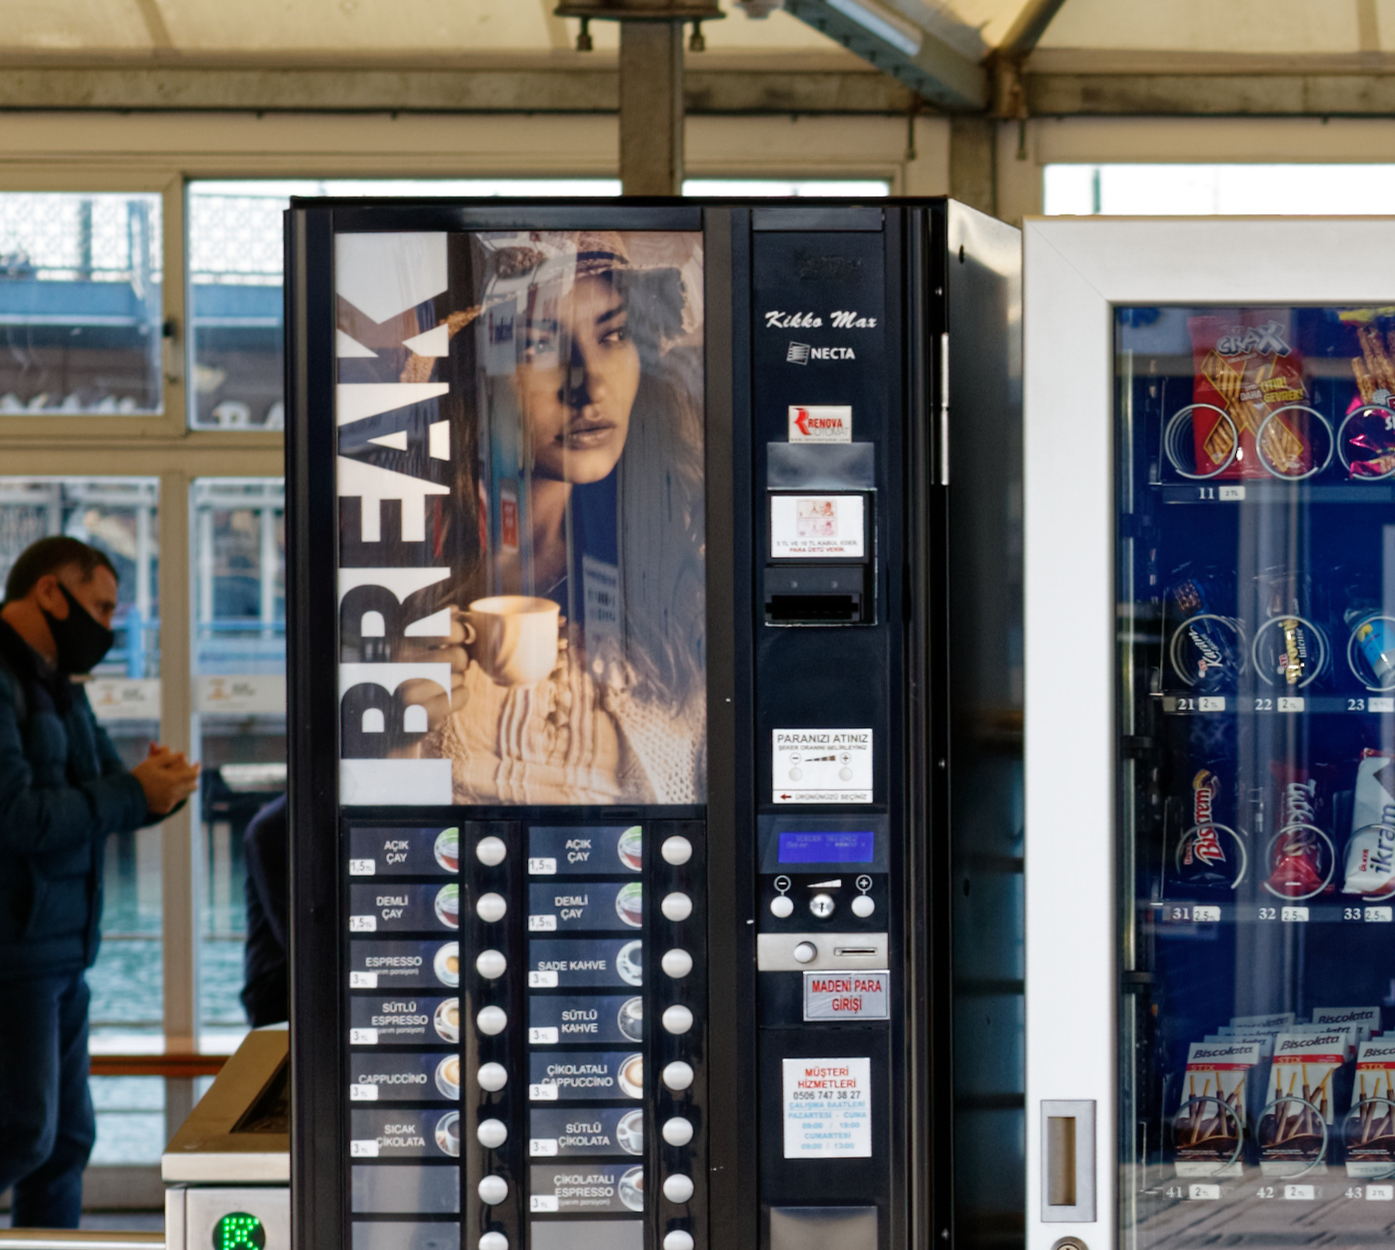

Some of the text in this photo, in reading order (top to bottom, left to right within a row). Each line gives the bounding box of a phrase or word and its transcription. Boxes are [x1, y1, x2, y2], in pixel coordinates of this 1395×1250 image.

[765, 311, 877, 328] Kikko Max
[811, 347, 856, 360] NECTA
[808, 418, 842, 428] RENOVA
[1199, 488, 1215, 500] 11
[336, 288, 452, 759] BREAK
[1177, 698, 1194, 711] 21
[777, 734, 868, 743] PARANIZI ATINIZ
[795, 793, 867, 802] ÜRÜNÜNÜZÜ SEÇİNİZ
[384, 840, 409, 852] AÇIK
[565, 839, 592, 851] AÇIK
[386, 852, 407, 864] ÇAY
[567, 851, 589, 863] ÇAY
[351, 860, 365, 872] 1,5
[530, 859, 545, 871] 1,5
[376, 895, 408, 906] DEMLİ
[555, 895, 588, 906] DEMLİ
[381, 908, 403, 921] ÇAY
[560, 908, 583, 920] ÇAY
[1172, 908, 1189, 920] 31
[1344, 908, 1361, 920] 33
[365, 956, 422, 967] ESPRESSO
[538, 960, 606, 971] SADE KAHVE
[812, 977, 882, 993] MADENİ PARA
[382, 1001, 417, 1013] SÜTLÜ
[832, 995, 862, 1014] GİRİŞİ
[371, 1015, 428, 1026] ESPRESSO
[562, 1009, 598, 1021] SÜTLÜ
[562, 1023, 598, 1033] KAHVE
[1281, 1035, 1340, 1051] Biscolata
[1193, 1044, 1254, 1059] Biscolata
[547, 1063, 607, 1076] ÇİKOLATALI
[805, 1067, 849, 1078] MÜŞTERİ
[358, 1073, 427, 1084] CAPPUCCİNO
[798, 1078, 856, 1089] HİZMETLERİ
[794, 1090, 861, 1100] 0506 747 38 27
[384, 1124, 415, 1135] SICAK
[566, 1122, 602, 1134] SÜTLÜ
[558, 1135, 610, 1147] ÇİKOLATA
[553, 1174, 614, 1186] ÇİKOLATALI
[554, 1187, 614, 1198] ESPRESSO
[1345, 1187, 1363, 1198] 43
